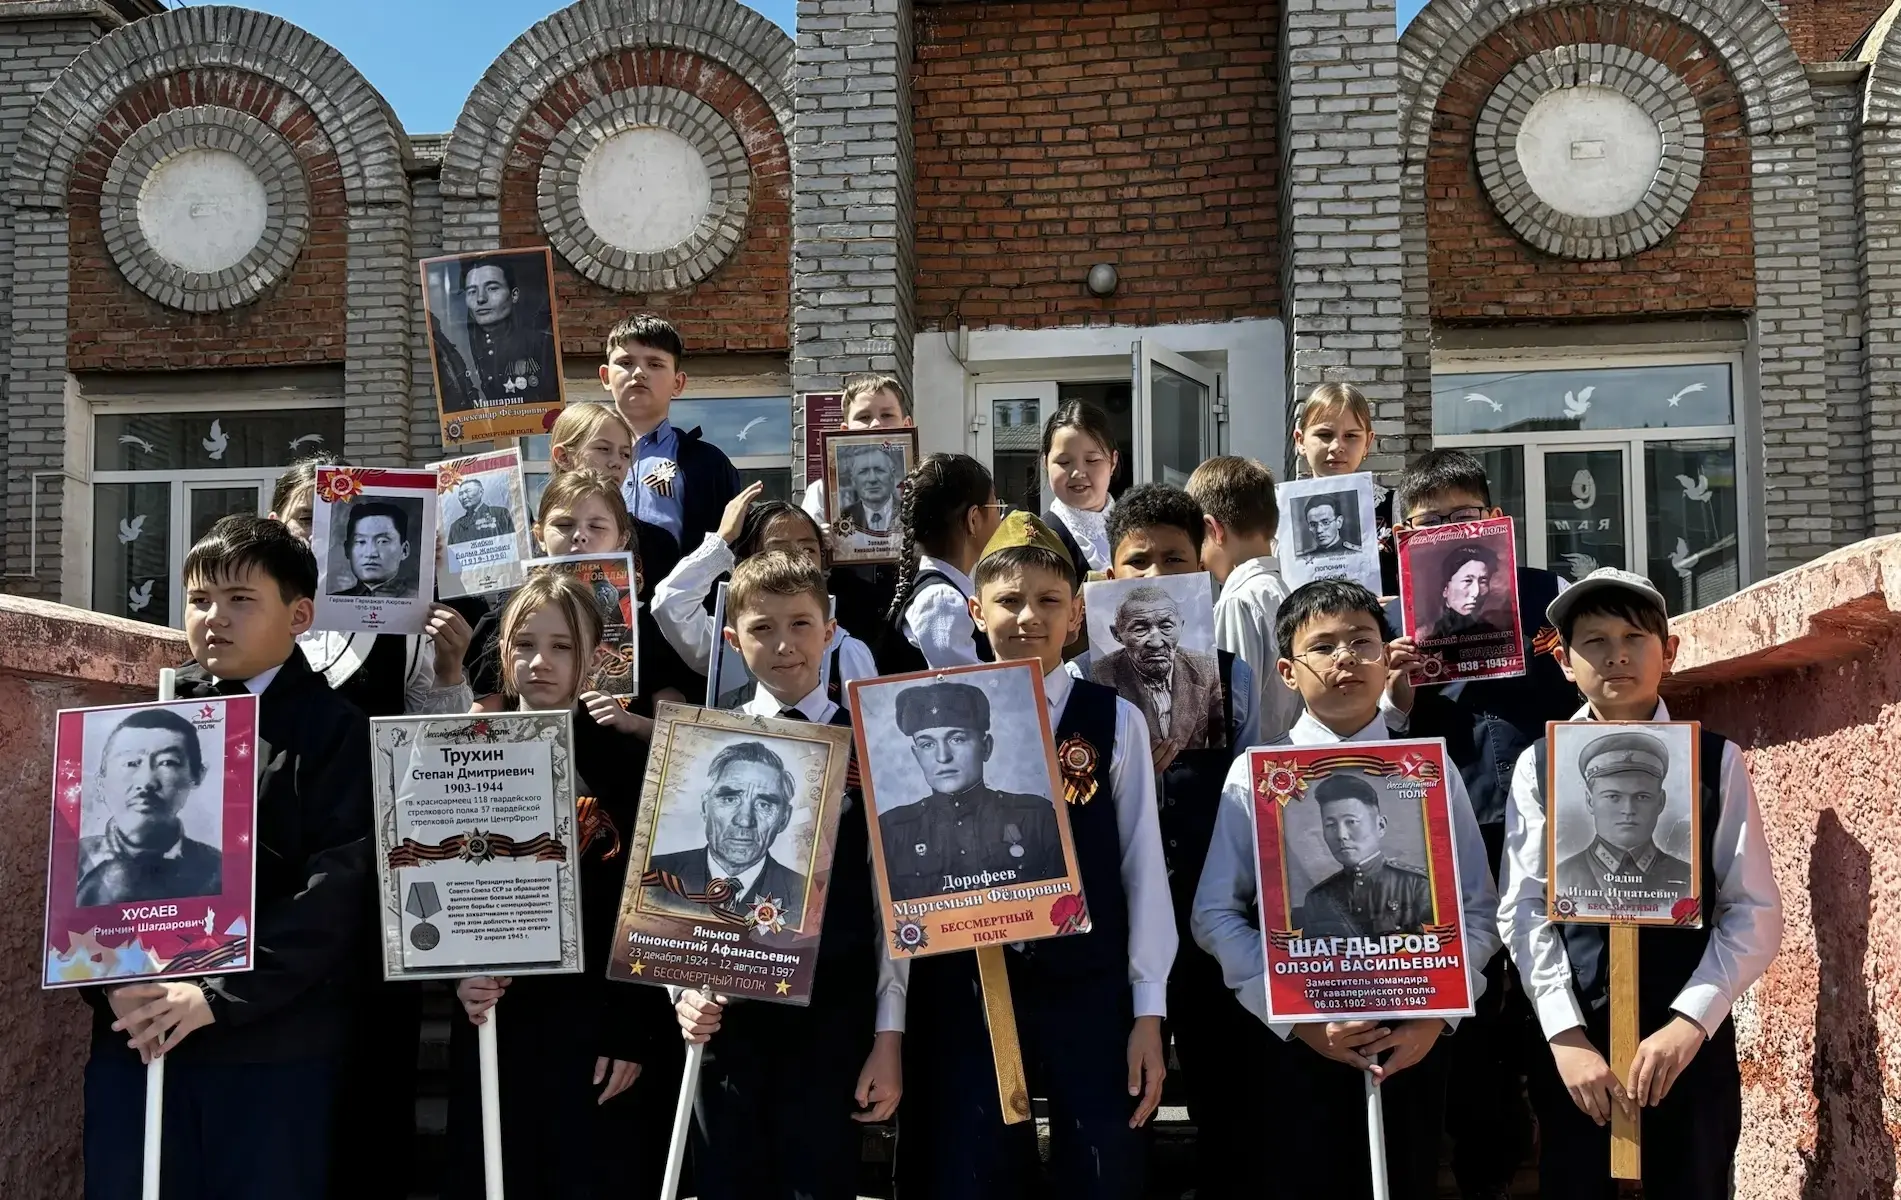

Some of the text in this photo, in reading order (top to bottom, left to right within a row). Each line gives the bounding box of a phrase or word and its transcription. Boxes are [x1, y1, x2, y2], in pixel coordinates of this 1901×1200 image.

[473, 396, 524, 409] Мишарин
[456, 411, 498, 423] Александр
[471, 430, 515, 440] БЕССМЕРТНЫЙ
[1571, 469, 1596, 510] 9
[1554, 518, 1610, 531] МАЯ
[1457, 660, 1479, 673] 1938
[1485, 657, 1507, 669] 1945
[440, 748, 504, 766] Трухин
[412, 766, 535, 781] Степан Дмитриевич
[444, 782, 504, 794] 1903-1944
[417, 797, 472, 807] красноармеец
[474, 796, 488, 804] 118
[491, 794, 542, 805] гвардейского
[407, 808, 454, 817] стрелкового
[456, 806, 479, 815] полка
[492, 804, 541, 814] гвардейской
[410, 814, 538, 826] стрелковой дивизии ЦентрФронт
[476, 879, 514, 887] Президиума
[942, 868, 1017, 891] Дорофеев
[1603, 873, 1643, 884] Фадин
[893, 881, 1073, 917] Мартемьян Фёдорович
[1568, 886, 1678, 899] Игнат Игнатьевич
[122, 904, 178, 921] ХУСАЕВ
[1587, 903, 1659, 912] БЕССМЕРТНЫЙ
[518, 917, 548, 925] мужество
[940, 909, 1034, 934] БЕССМЕРТНЫЙ
[1609, 913, 1637, 922] ПОЛК
[93, 919, 204, 937] Ринчин Шагдарович
[693, 925, 740, 942] Яньков
[973, 929, 1008, 943] ПОЛК
[628, 932, 801, 965] Иннокентий Афанасьевич
[1287, 934, 1441, 959] ШАГДЫРОВ
[628, 947, 642, 958] 23
[643, 949, 682, 964] декабря
[685, 954, 708, 966] 1924
[719, 959, 730, 970] 12
[733, 962, 768, 976] августа
[770, 965, 795, 978] 1997
[1275, 955, 1459, 975] ОЛЗОЙ ВАСИЛЬЕВИЧ
[653, 966, 766, 991] БЕССМЕРТНЫЙ ПОЛК
[1305, 975, 1429, 988] Заместитель командира
[1304, 986, 1436, 999] 127 кавалерийского полка
[1314, 998, 1366, 1009] 06.03.1902
[1375, 996, 1427, 1007] 30.10.1943
